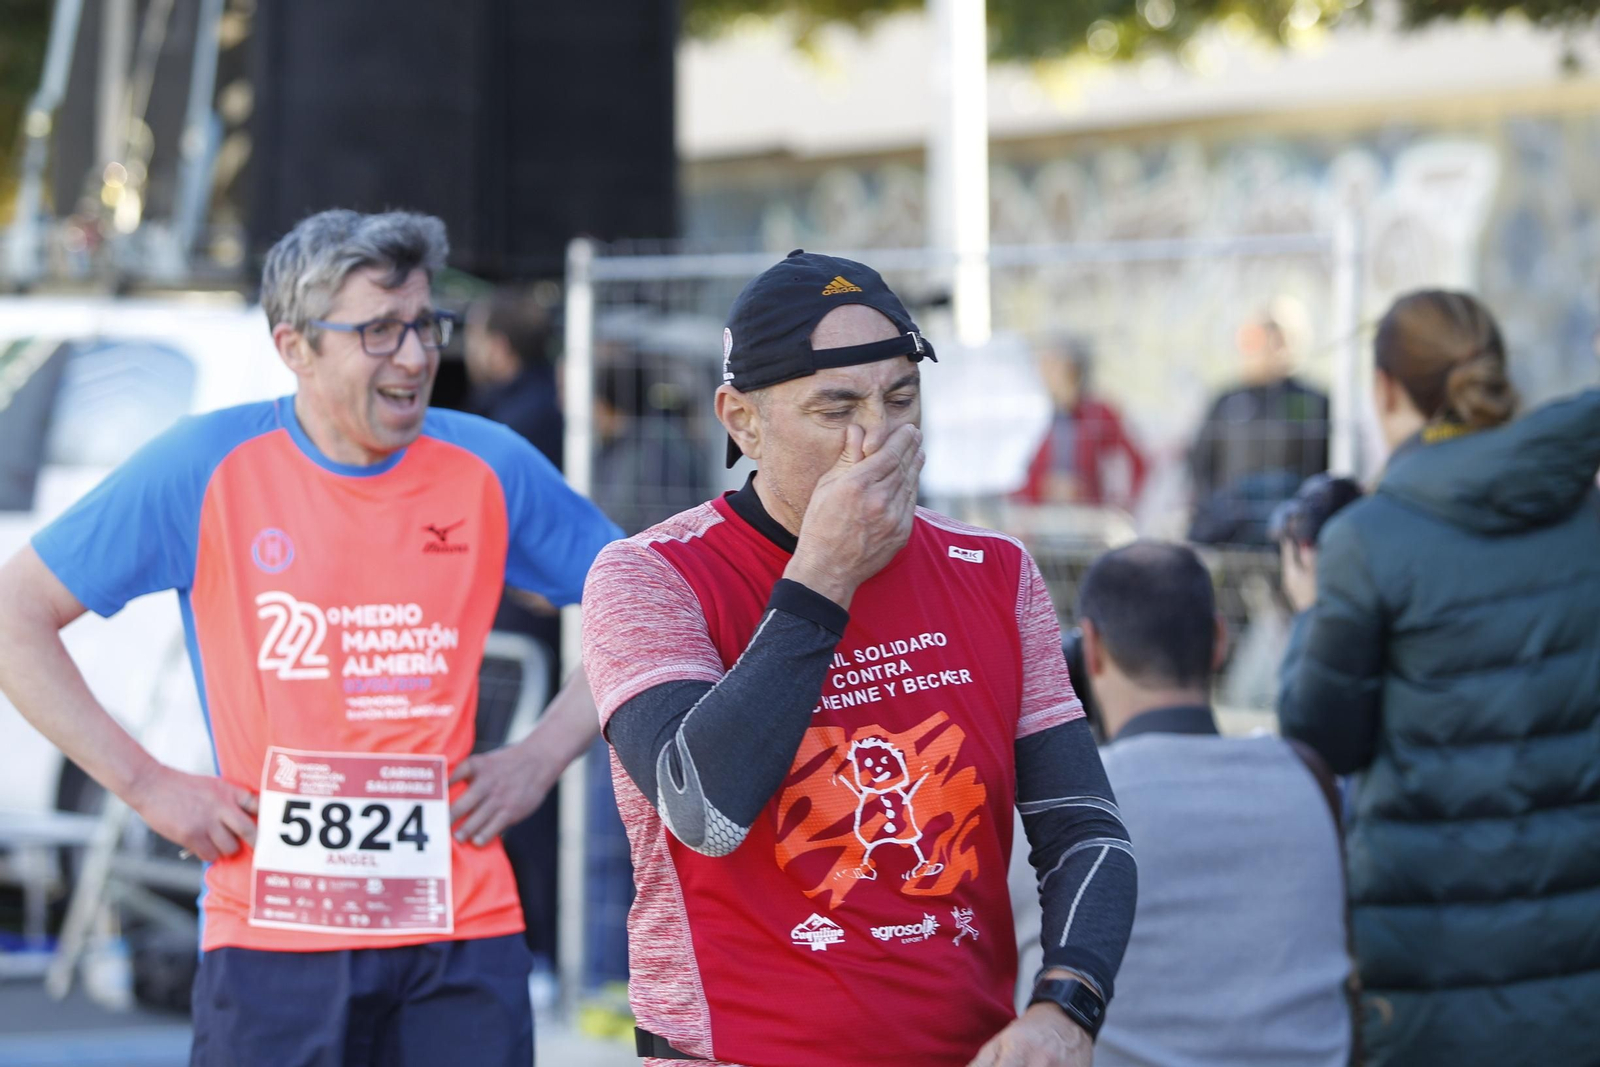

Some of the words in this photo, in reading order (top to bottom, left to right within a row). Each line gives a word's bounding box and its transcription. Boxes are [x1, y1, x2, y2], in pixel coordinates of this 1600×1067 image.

[821, 286, 863, 296] adidas
[341, 603, 423, 627] MEDIO
[341, 623, 459, 652] MARATÓN
[342, 648, 449, 677] ALMERÍA
[829, 652, 852, 669] IL
[832, 659, 913, 689] CONTRA
[884, 682, 897, 698] Y
[901, 669, 974, 694] BECKER
[279, 800, 429, 852] 5824
